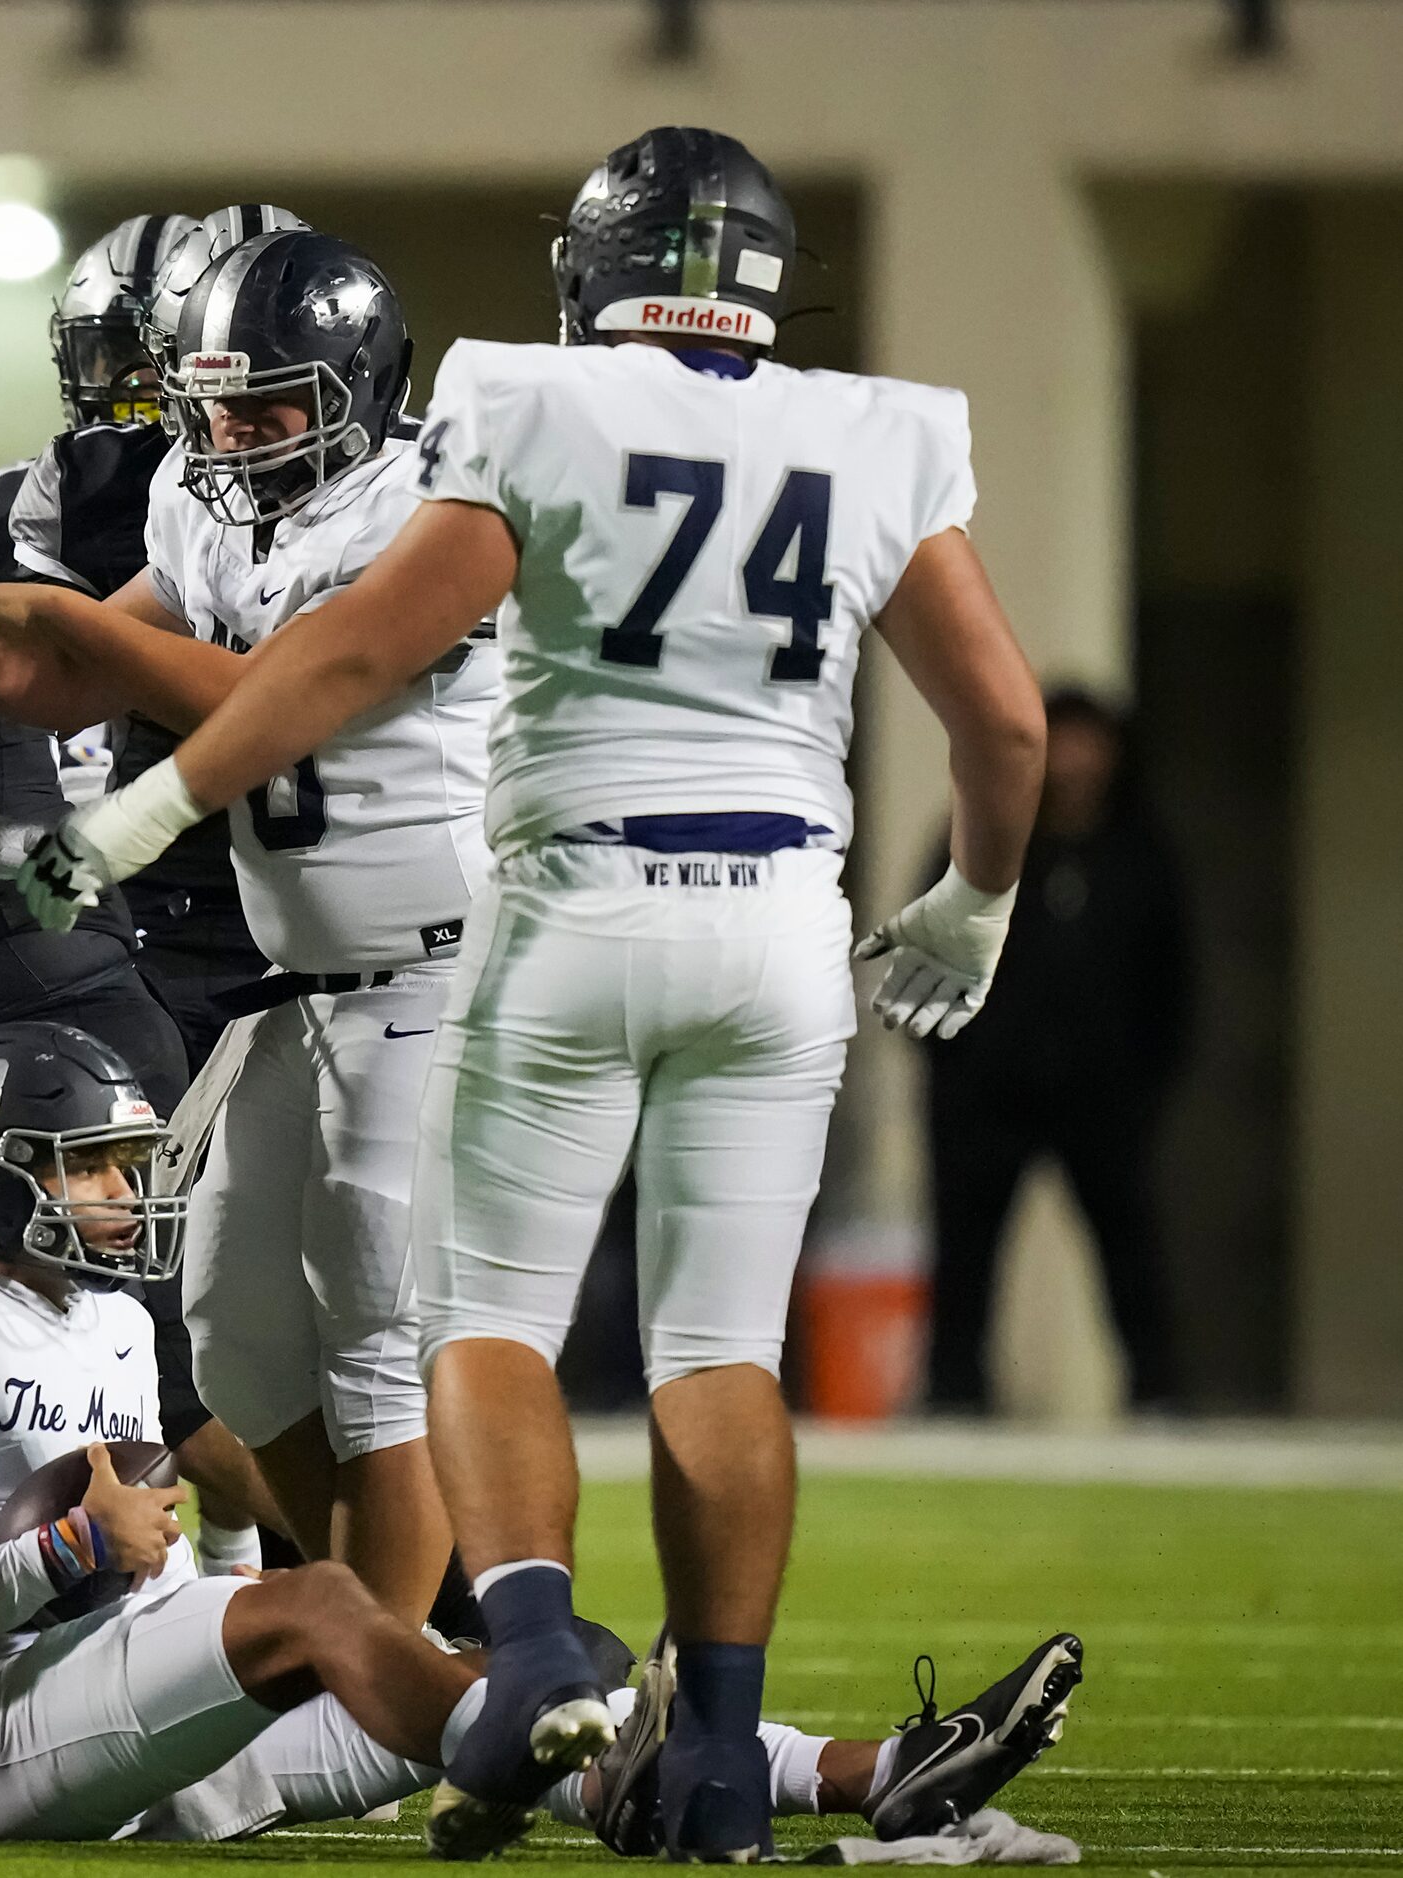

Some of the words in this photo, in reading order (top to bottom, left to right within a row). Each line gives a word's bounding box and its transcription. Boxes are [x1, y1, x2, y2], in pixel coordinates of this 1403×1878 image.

[642, 303, 752, 335] Riddell
[598, 451, 836, 686] 74
[643, 862, 669, 886] WE
[677, 862, 721, 886] WILL
[727, 862, 759, 887] WIN
[432, 927, 458, 942] XL
